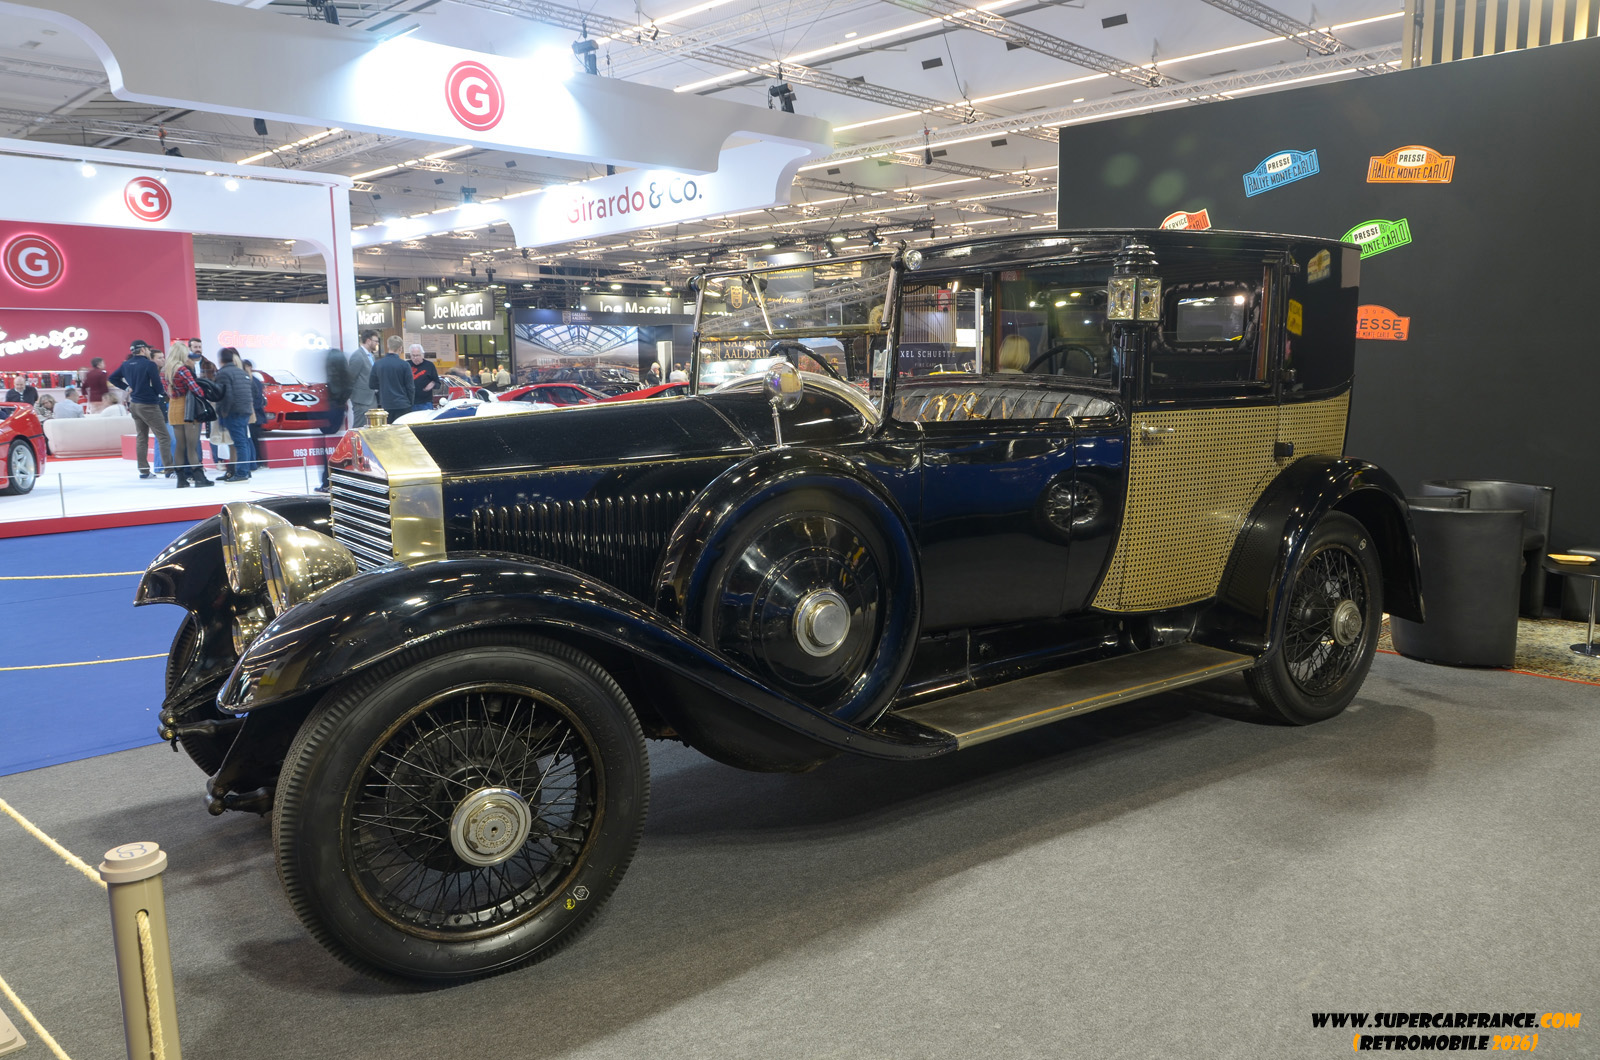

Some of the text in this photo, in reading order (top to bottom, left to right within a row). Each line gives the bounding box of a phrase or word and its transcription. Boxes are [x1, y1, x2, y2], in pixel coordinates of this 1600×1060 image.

[458, 76, 491, 116] G
[1267, 156, 1291, 171] PRESSE
[1398, 154, 1425, 163] PRESSE
[1372, 159, 1396, 179] RALLYE
[1247, 175, 1270, 193] RALLYE
[134, 186, 160, 213] G
[566, 178, 703, 224] Girardo & Co.
[1353, 226, 1379, 241] PRESSE
[1362, 223, 1407, 254] ONTE-CARLO
[17, 246, 50, 277] G
[358, 308, 385, 325] Macari
[432, 298, 483, 320] Joe Macari
[900, 350, 957, 358] XEL SCHUETTE
[286, 393, 317, 402] 20
[292, 446, 336, 457] 1963 FERRARI
